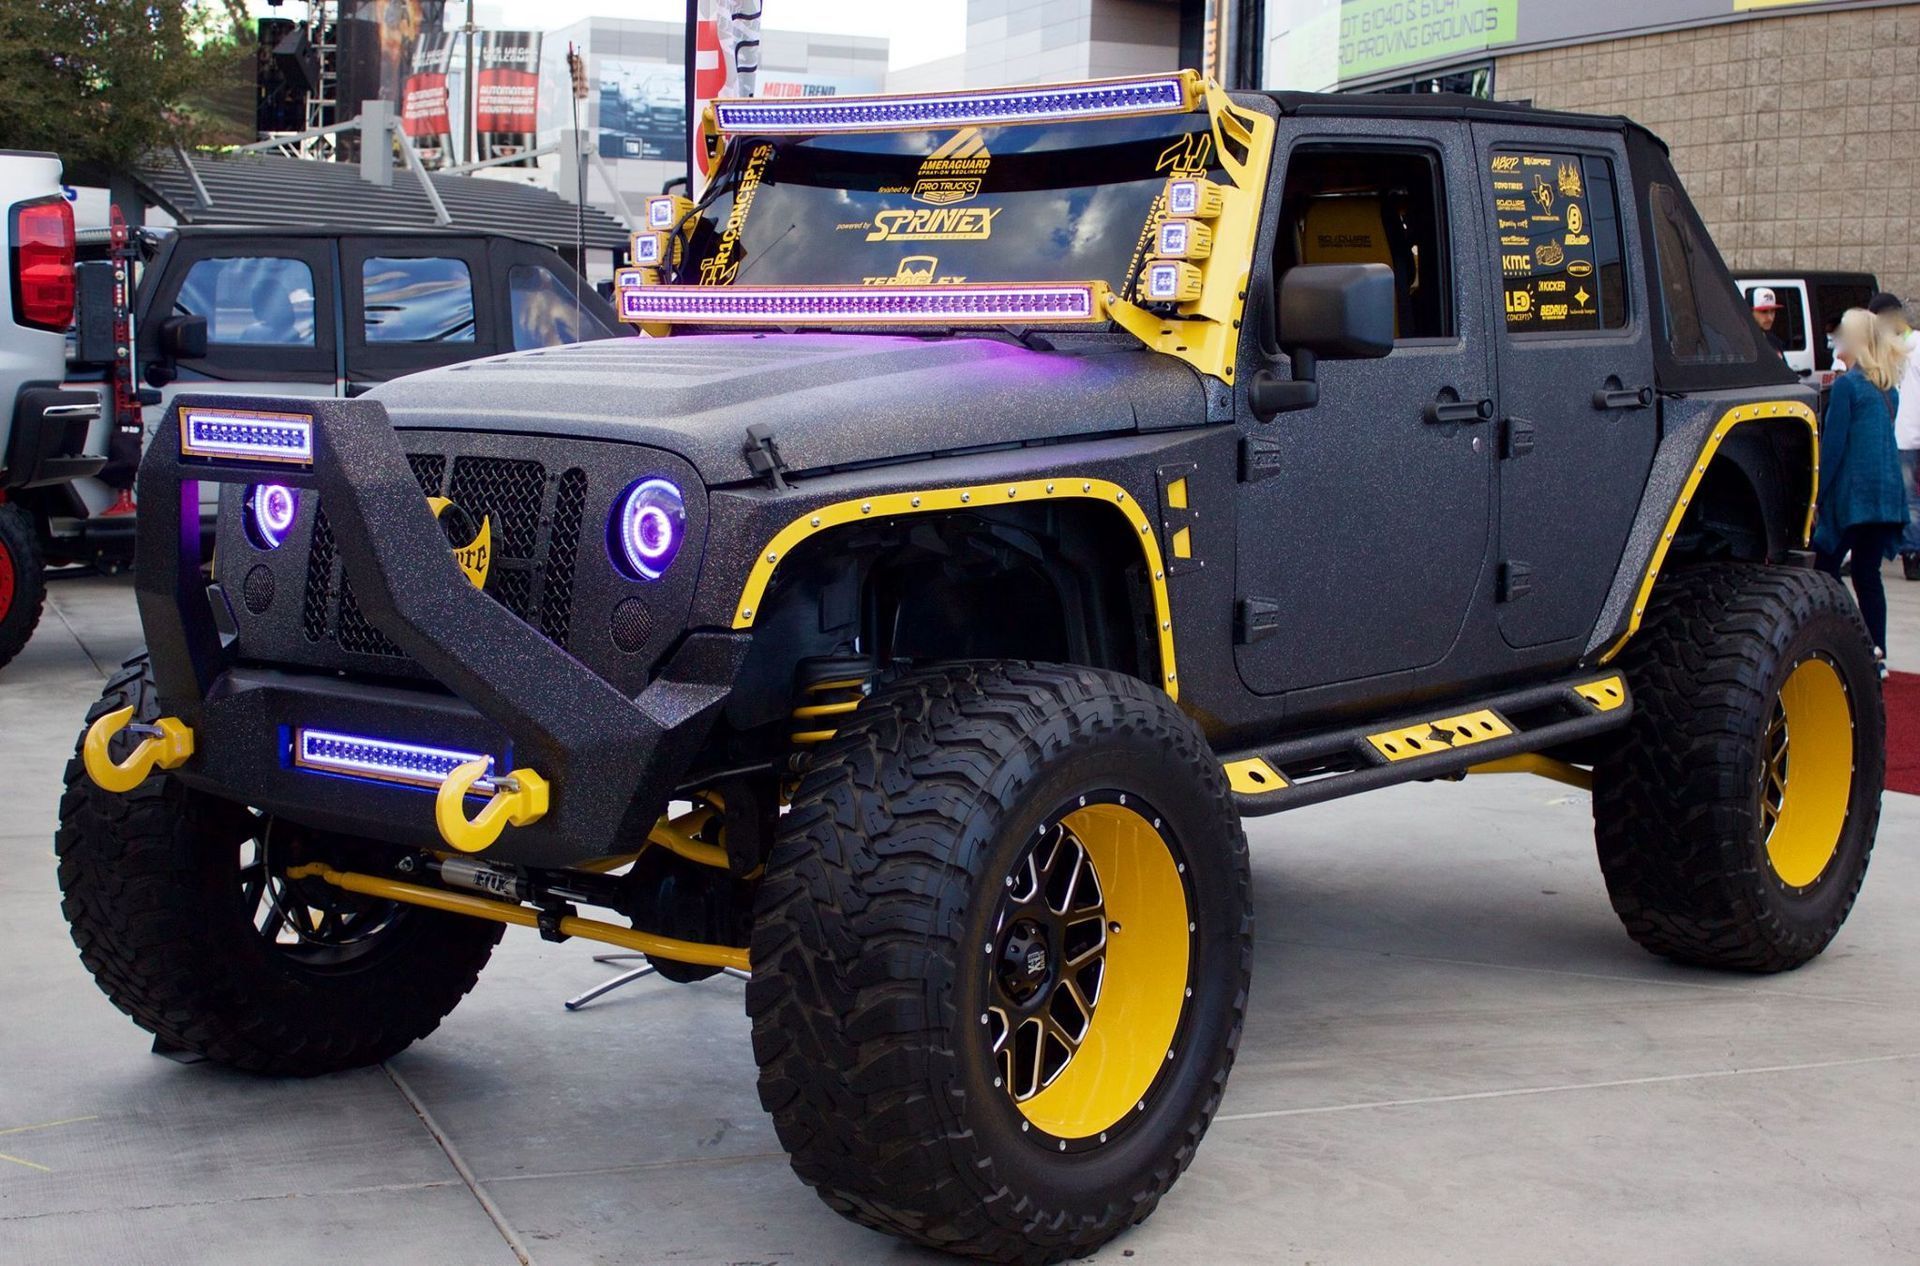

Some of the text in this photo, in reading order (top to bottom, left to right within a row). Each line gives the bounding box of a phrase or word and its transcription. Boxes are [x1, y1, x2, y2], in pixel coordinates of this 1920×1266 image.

[1359, 27, 1418, 58] PROVING
[1421, 7, 1498, 46] GROUNDS
[920, 159, 991, 170] AMERAGUARD
[918, 182, 975, 193] PRO TRUCKS
[836, 222, 872, 231] powered by
[866, 208, 1003, 241] SPRINTEX
[1502, 255, 1531, 270] KMC
